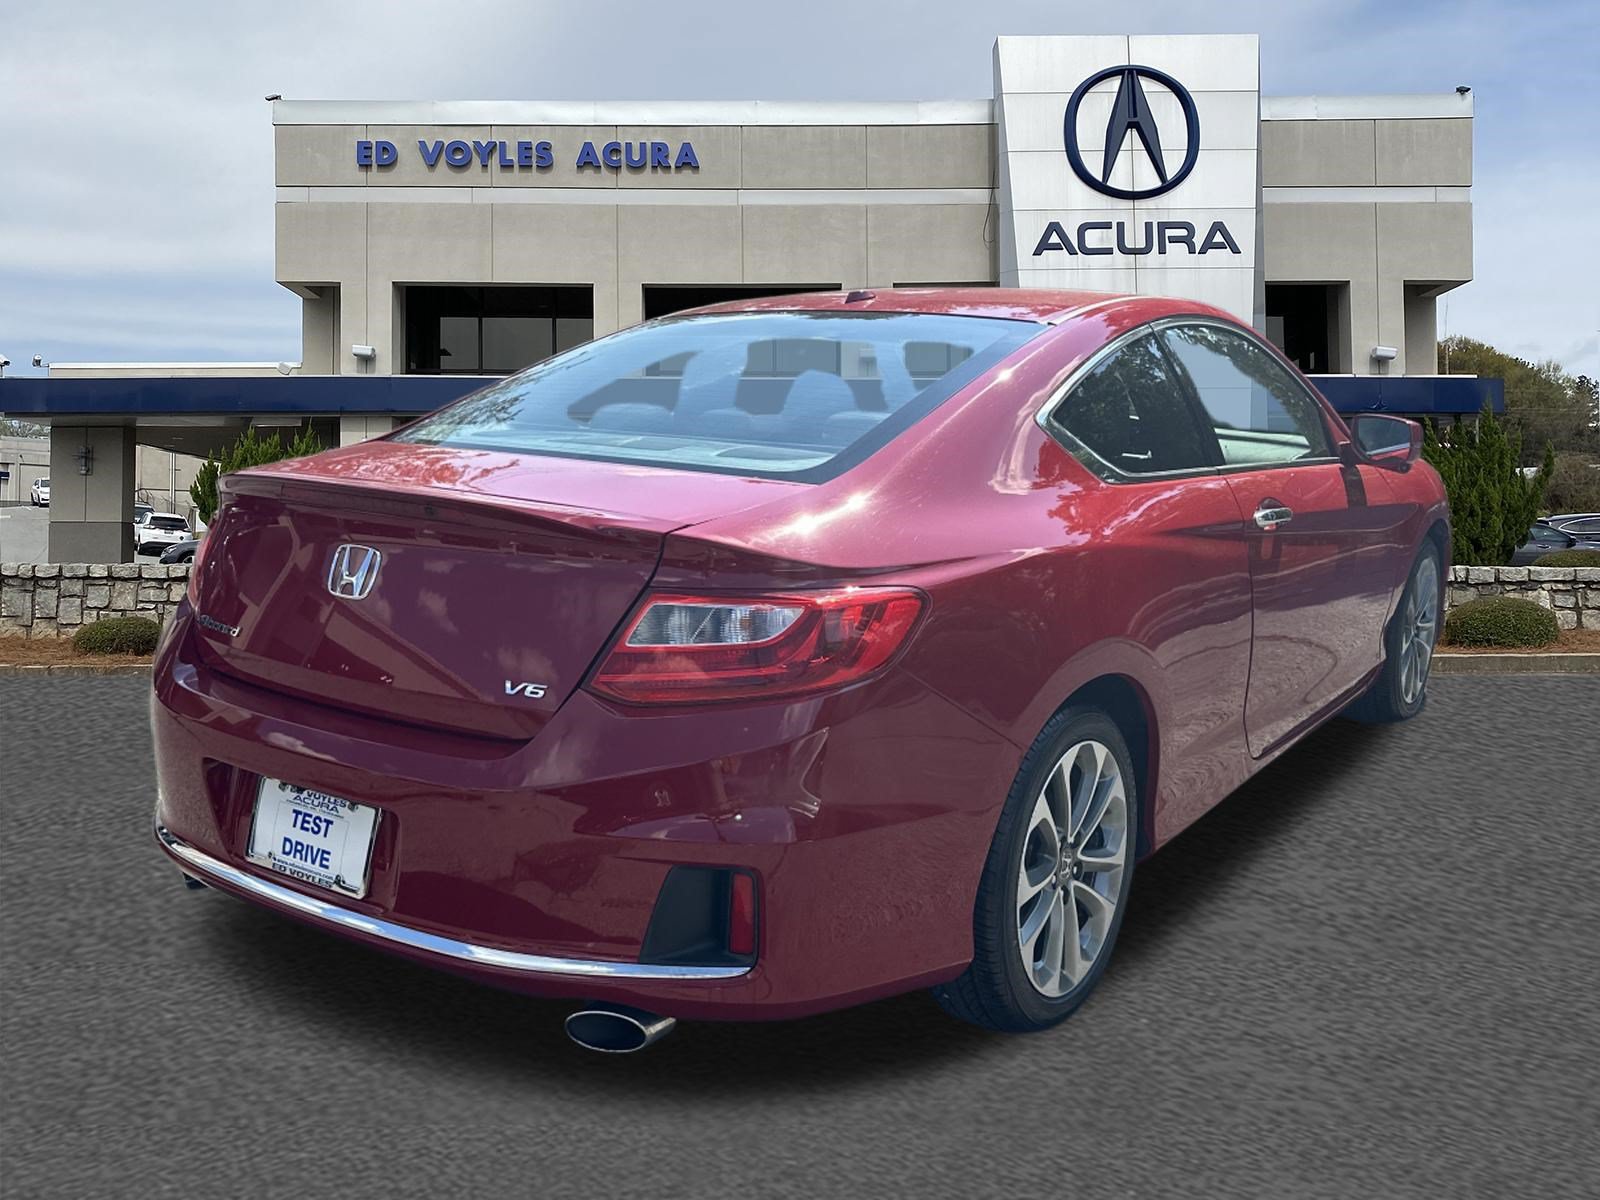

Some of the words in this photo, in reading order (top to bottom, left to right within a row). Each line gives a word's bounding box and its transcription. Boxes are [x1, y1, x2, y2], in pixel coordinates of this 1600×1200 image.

[356, 140, 398, 168] ED
[418, 140, 554, 168] VOYLES
[576, 141, 700, 168] ACURA
[1032, 221, 1242, 256] ACURA
[505, 680, 548, 698] V6
[293, 794, 340, 814] ACURA
[292, 808, 334, 838] TEST
[281, 836, 332, 869] DRIVE
[272, 862, 287, 873] ED
[289, 868, 335, 889] VOYLES
